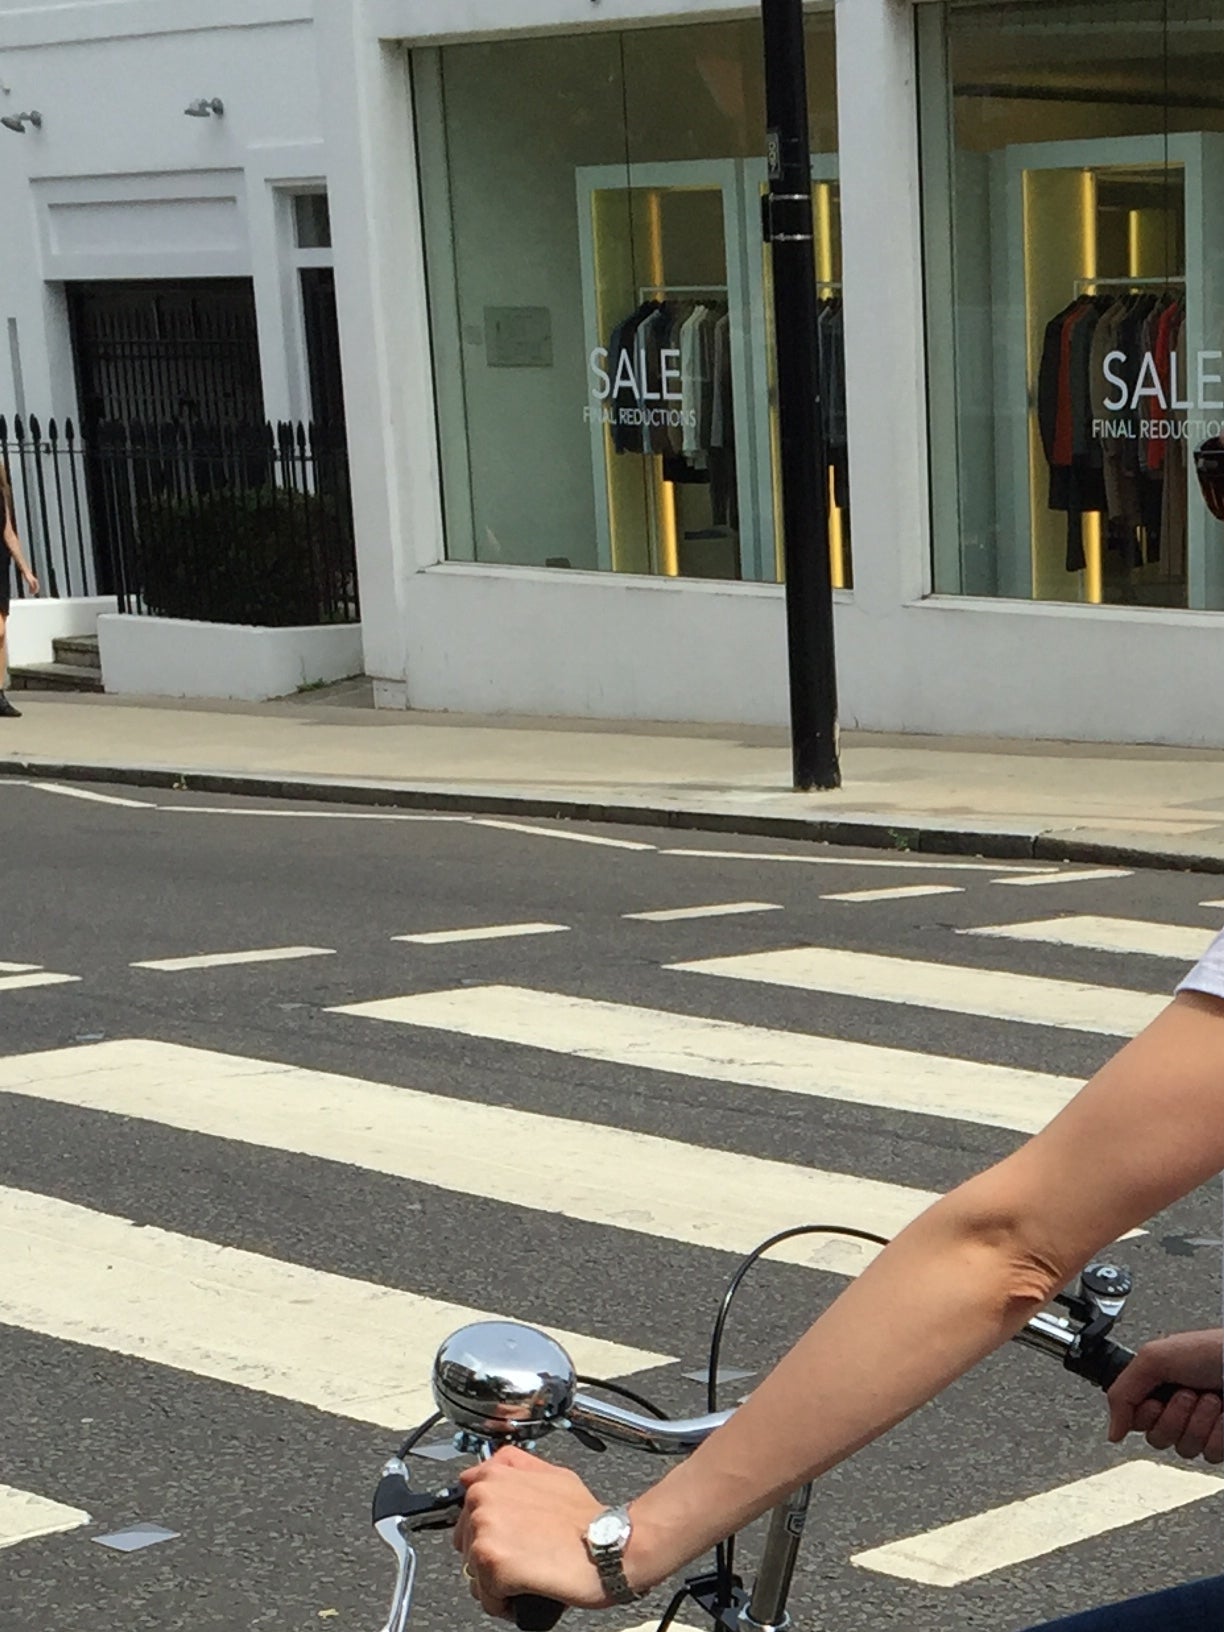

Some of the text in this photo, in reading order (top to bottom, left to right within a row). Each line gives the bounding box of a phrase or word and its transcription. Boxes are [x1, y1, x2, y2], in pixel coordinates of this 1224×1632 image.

[590, 347, 682, 400] SALE
[1103, 350, 1224, 411] SALE
[619, 408, 697, 428] REDUCTIONS
[1092, 418, 1136, 439] FINAL
